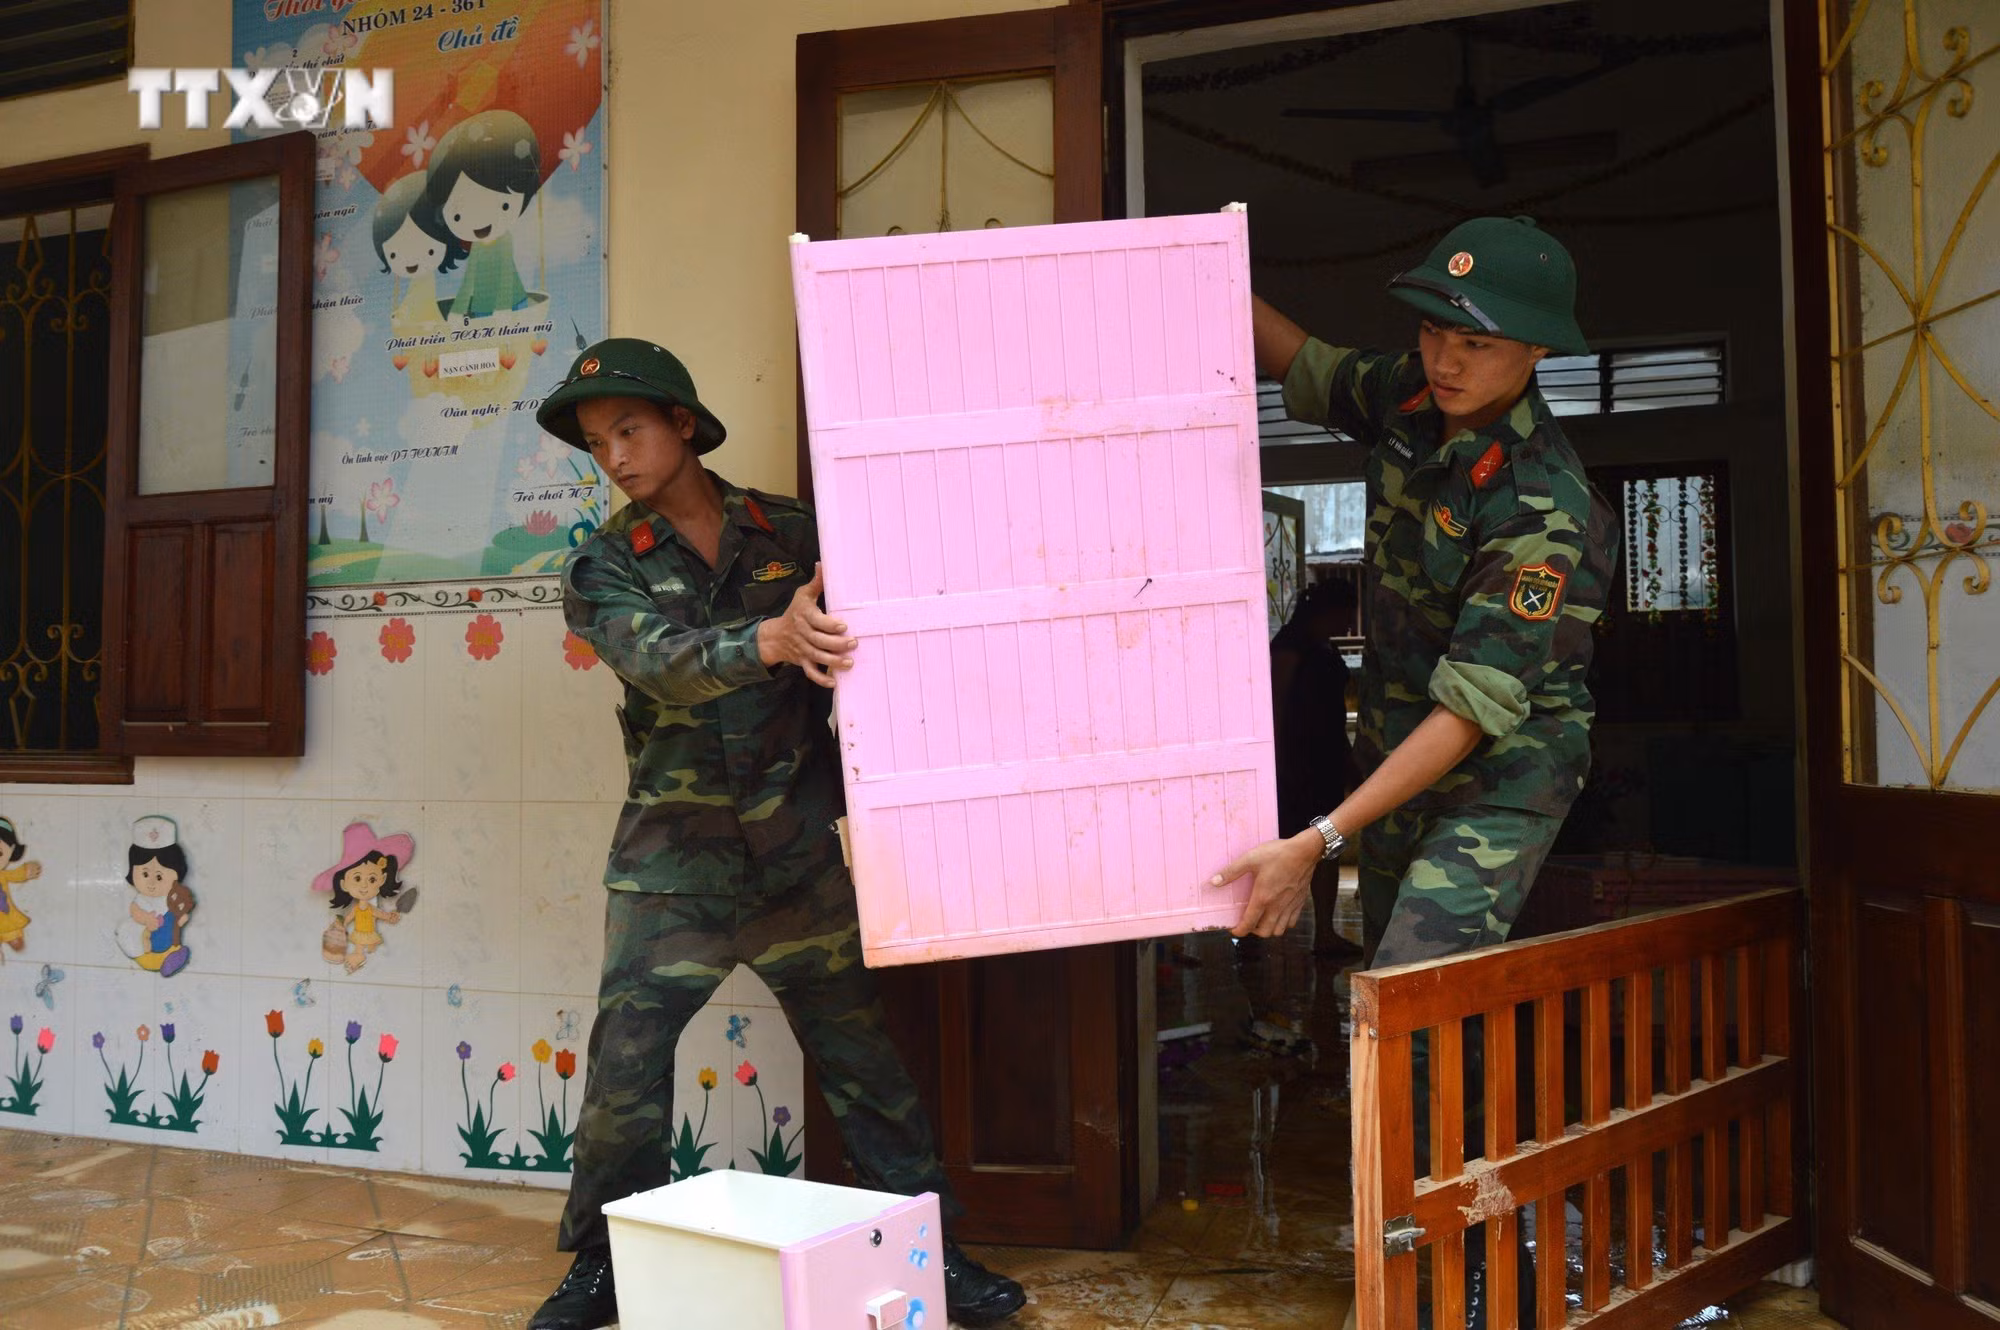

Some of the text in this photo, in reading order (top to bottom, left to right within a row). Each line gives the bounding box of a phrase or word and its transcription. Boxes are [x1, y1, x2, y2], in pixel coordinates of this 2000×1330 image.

[342, 9, 407, 35] NHÓM
[412, 5, 434, 21] 24
[438, 17, 519, 51] Chủ đề
[292, 49, 298, 58] 2
[464, 317, 470, 327] 6
[385, 336, 417, 350] Phát
[533, 320, 553, 332] mỹ
[512, 491, 534, 502] Trò
[538, 489, 564, 501] chơi
